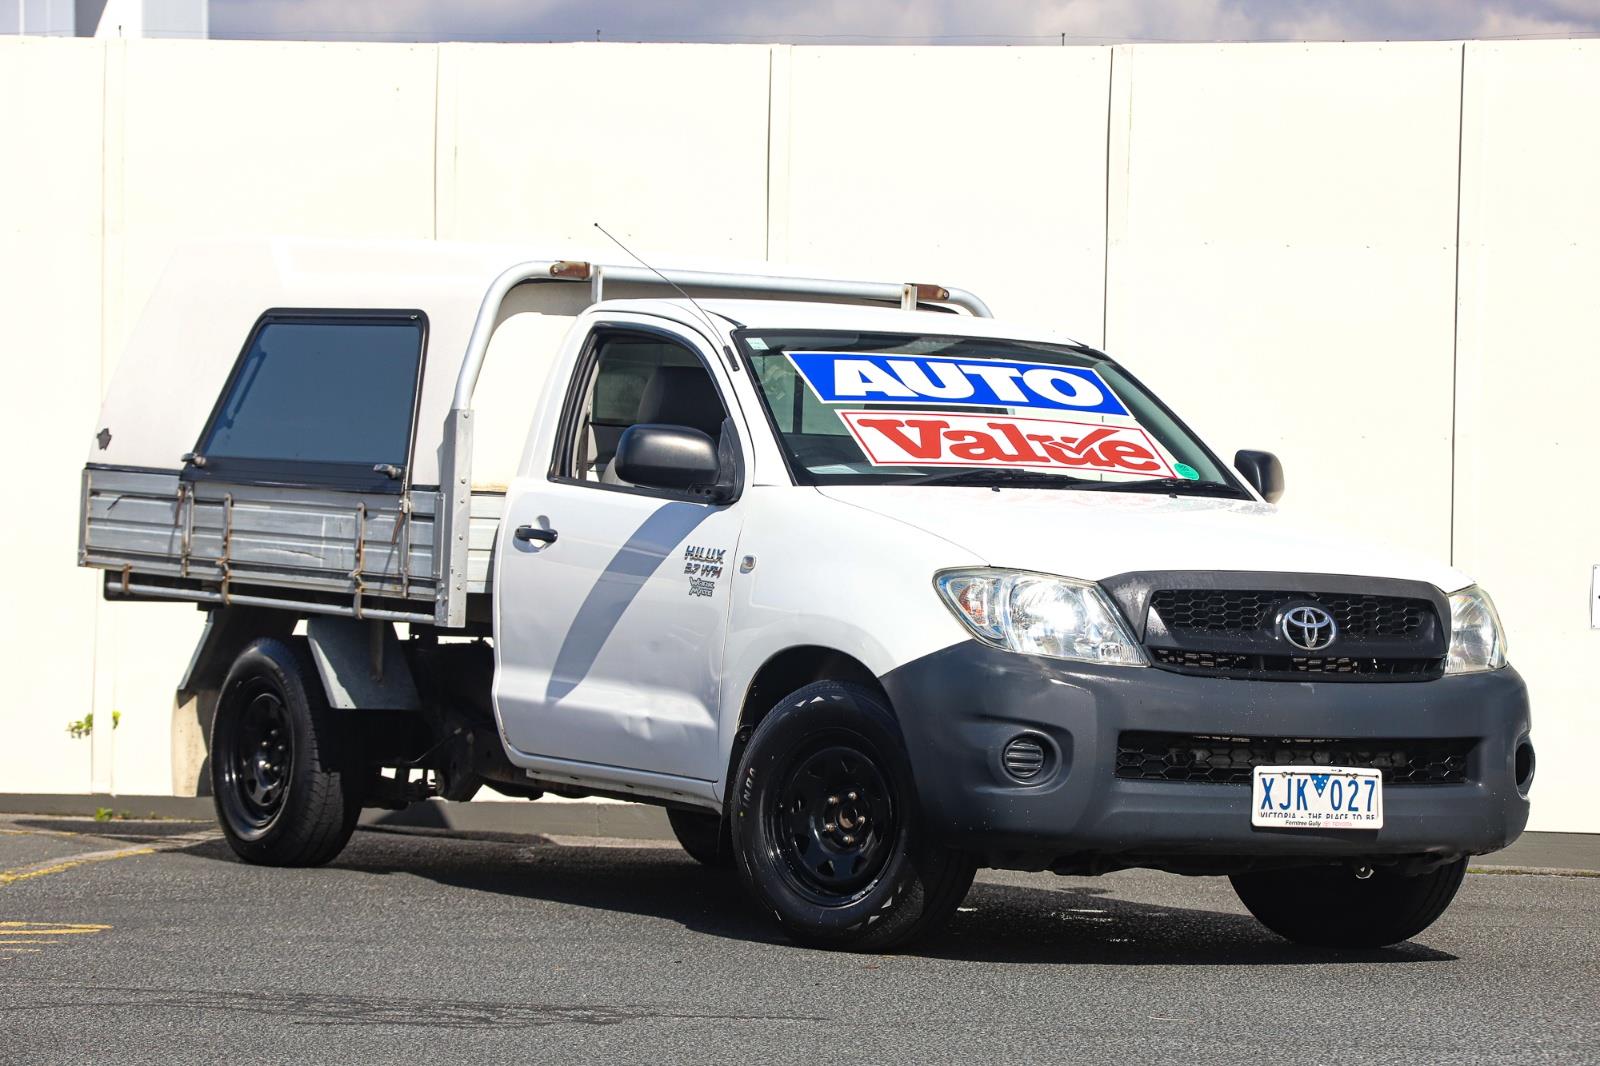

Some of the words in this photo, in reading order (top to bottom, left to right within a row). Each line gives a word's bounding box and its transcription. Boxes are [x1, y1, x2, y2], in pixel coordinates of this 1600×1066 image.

[834, 359, 1103, 407] AUTO
[856, 418, 1161, 470] Value
[684, 545, 727, 564] HILUX
[1260, 778, 1308, 811] XJK
[1330, 779, 1376, 812] 027
[1260, 811, 1297, 819] VICTORIA
[1308, 812, 1322, 820] THE
